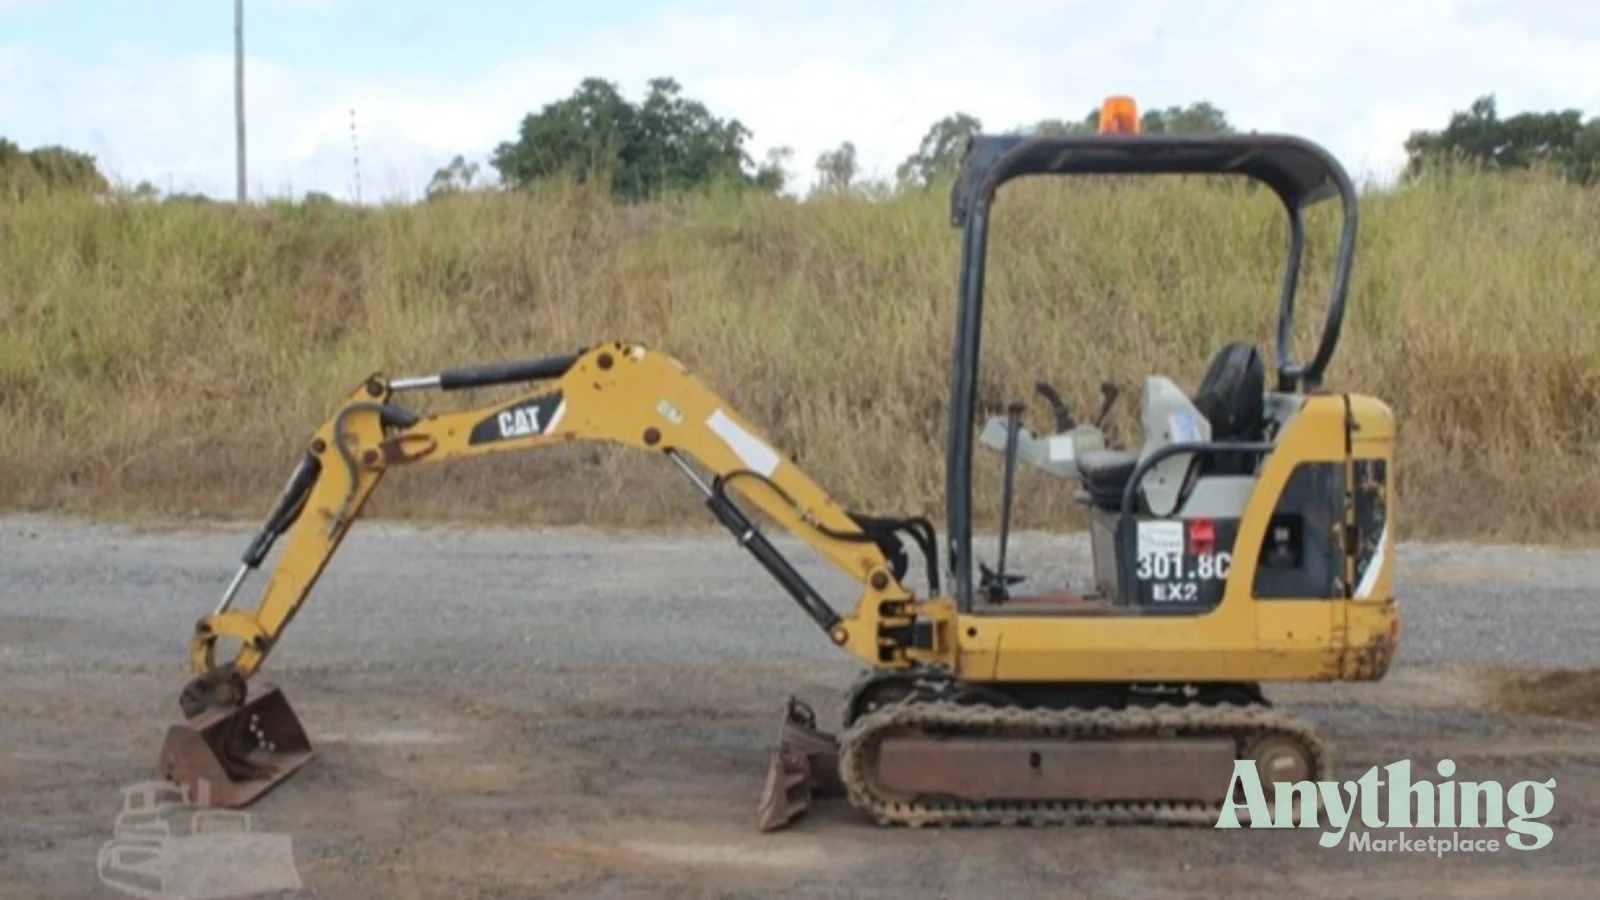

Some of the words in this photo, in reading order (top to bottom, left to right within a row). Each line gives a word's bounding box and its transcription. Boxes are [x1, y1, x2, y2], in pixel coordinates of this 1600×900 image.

[498, 405, 540, 437] CAT
[1136, 552, 1231, 579] 301.8C
[1153, 583, 1198, 601] EX2
